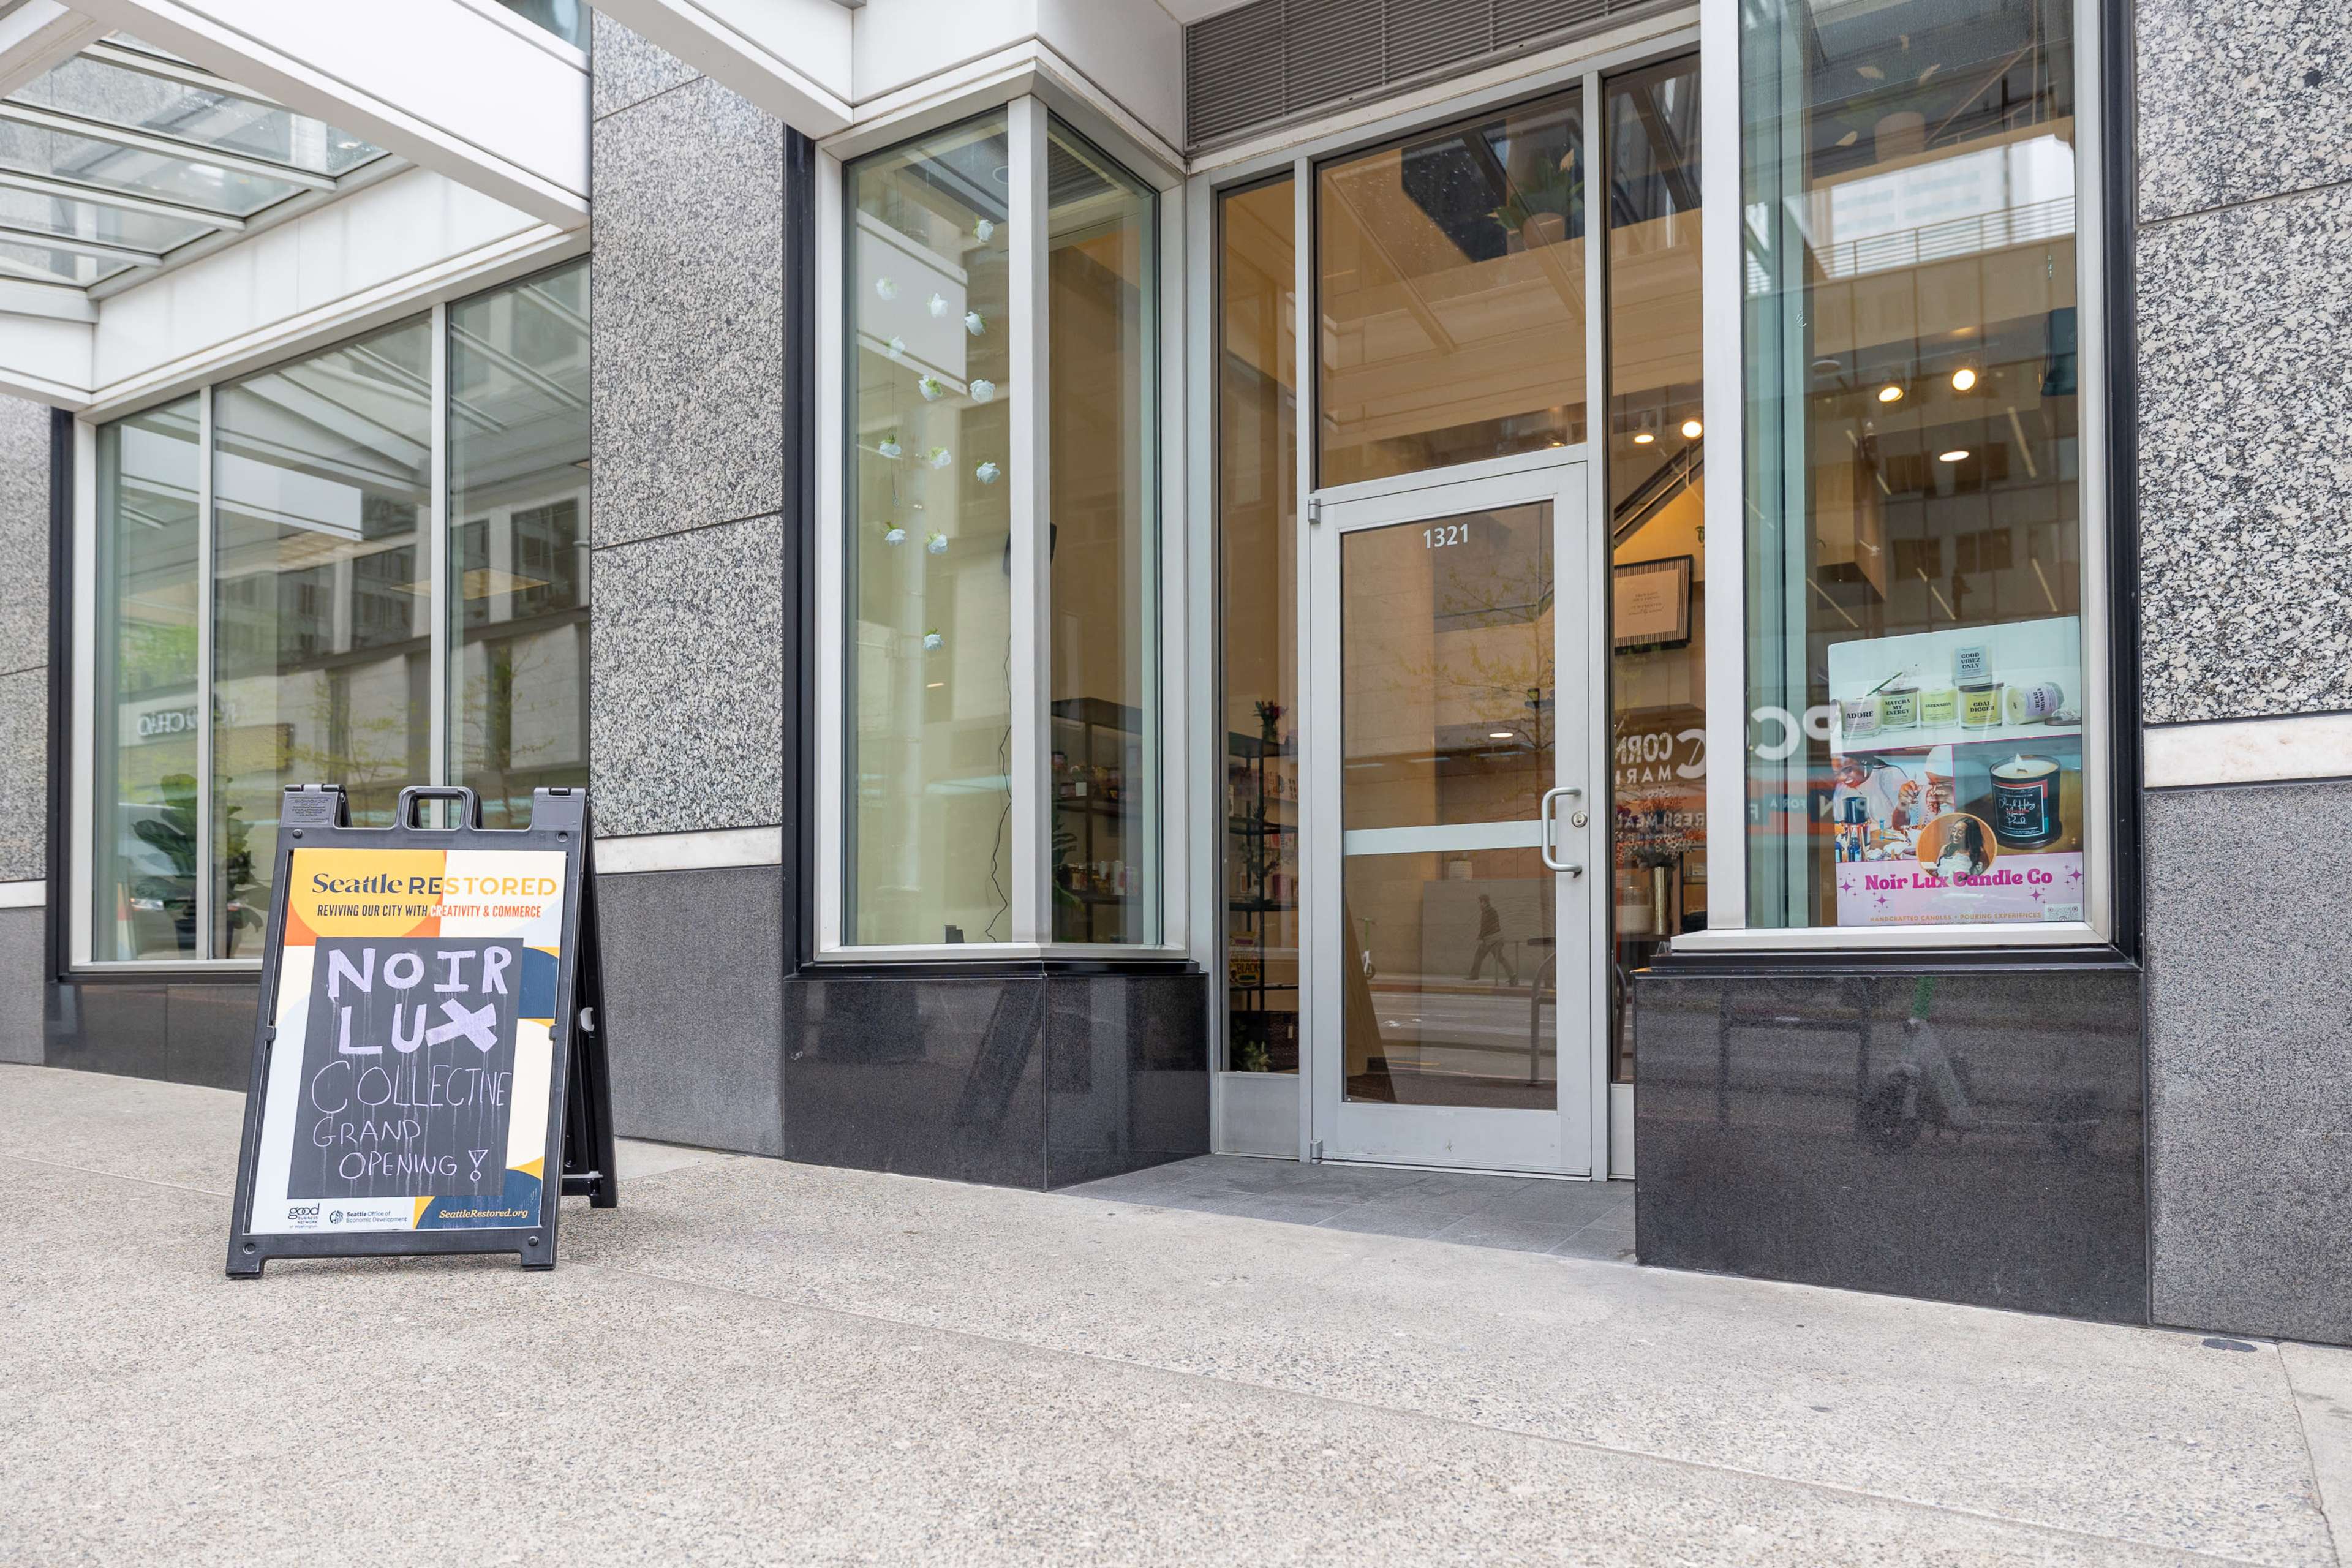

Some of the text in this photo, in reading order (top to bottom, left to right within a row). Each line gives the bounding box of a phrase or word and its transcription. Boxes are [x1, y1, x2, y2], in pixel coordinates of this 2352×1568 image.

[1423, 523, 1468, 549] 1321
[1847, 710, 1874, 719] ADORE
[312, 873, 557, 896] Seattle RESTORED
[1864, 868, 2053, 890] Noir Lux Candle Co
[317, 904, 541, 918] REVIVING OUR CITY WITH CREATIVITY & COMMERCE
[328, 946, 512, 1000] NOIR
[339, 998, 498, 1054] LUX
[311, 1060, 512, 1114] COLLECTIVE
[313, 1117, 420, 1147] GRAND
[339, 1150, 458, 1180] OPENING
[288, 1203, 320, 1220] good
[439, 1208, 529, 1218] SeattleRestored.org
